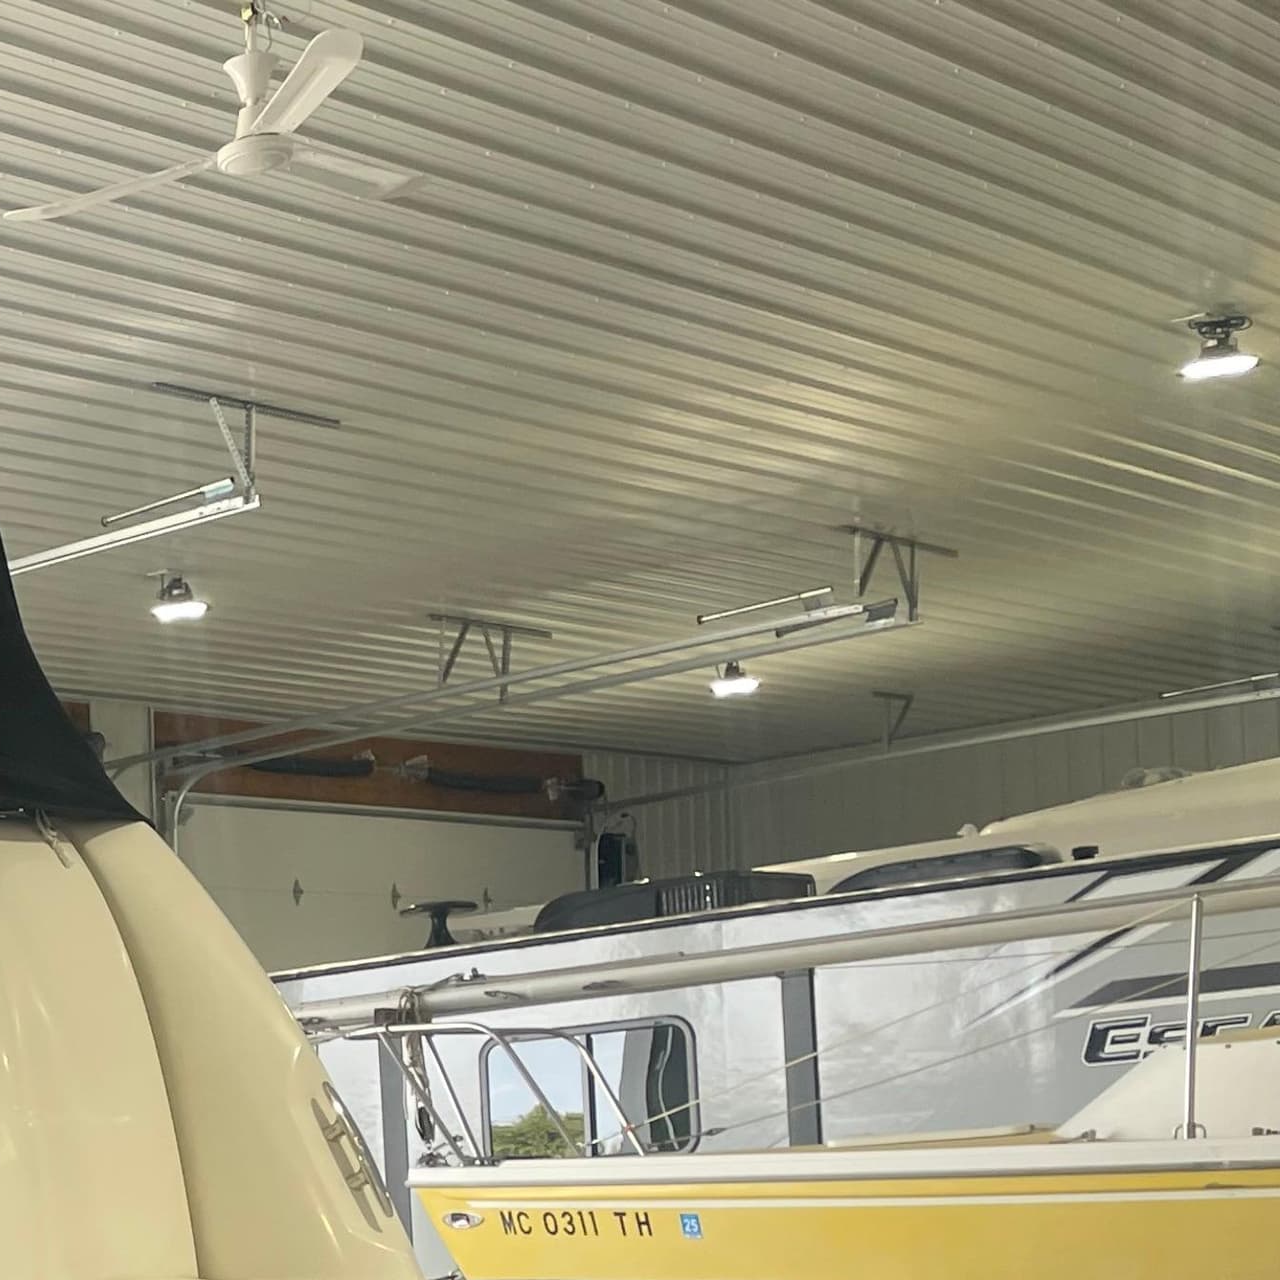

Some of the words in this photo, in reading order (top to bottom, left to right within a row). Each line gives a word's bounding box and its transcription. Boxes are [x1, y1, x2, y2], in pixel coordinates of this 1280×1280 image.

[499, 1210, 533, 1236] MC
[543, 1210, 600, 1236] 0311
[683, 1217, 699, 1233] 25
